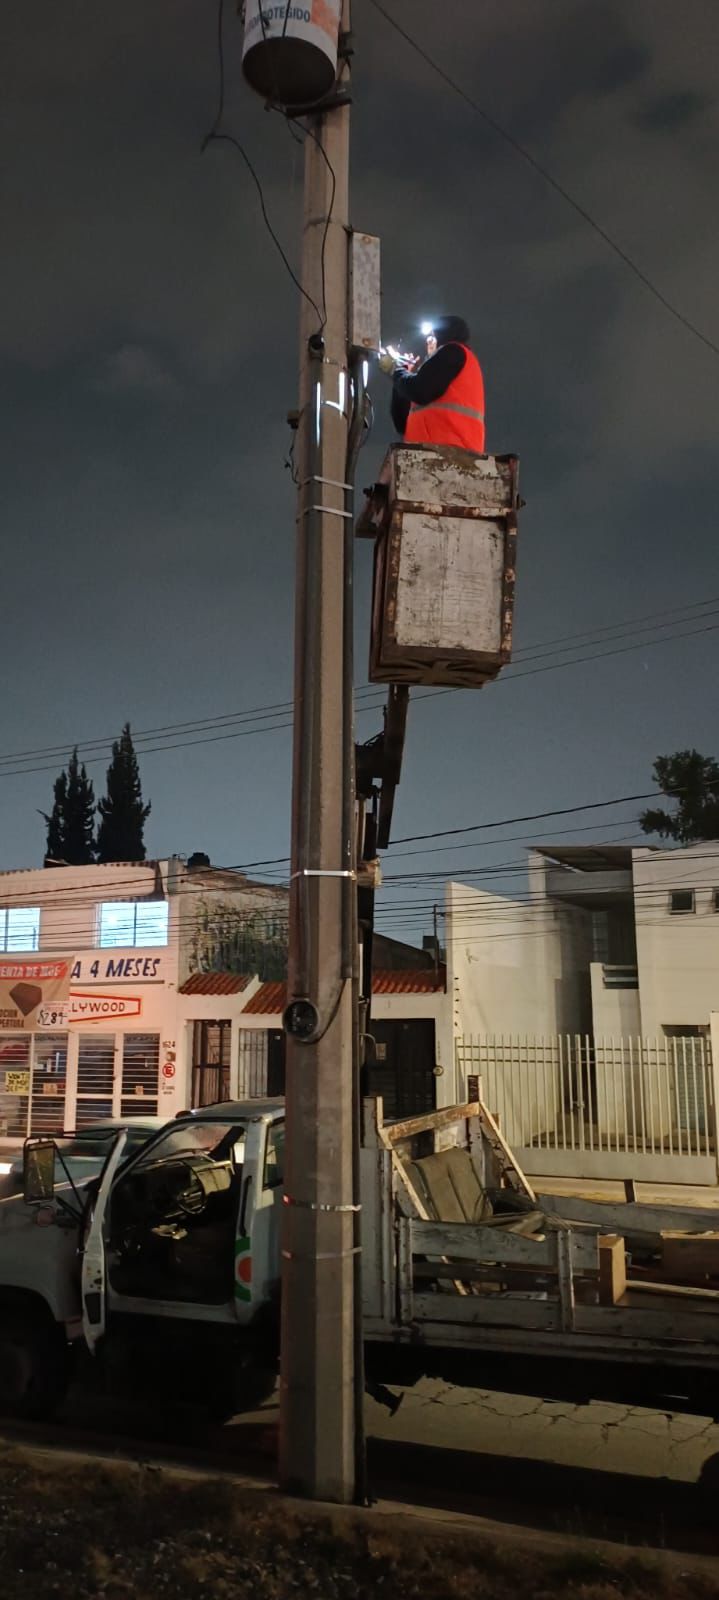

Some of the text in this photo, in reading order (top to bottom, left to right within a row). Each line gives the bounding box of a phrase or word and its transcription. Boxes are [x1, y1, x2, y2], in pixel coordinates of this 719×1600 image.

[0, 966, 23, 978] ENTA
[70, 958, 160, 979] A 4 MESES
[68, 1002, 125, 1013] LYWOOD
